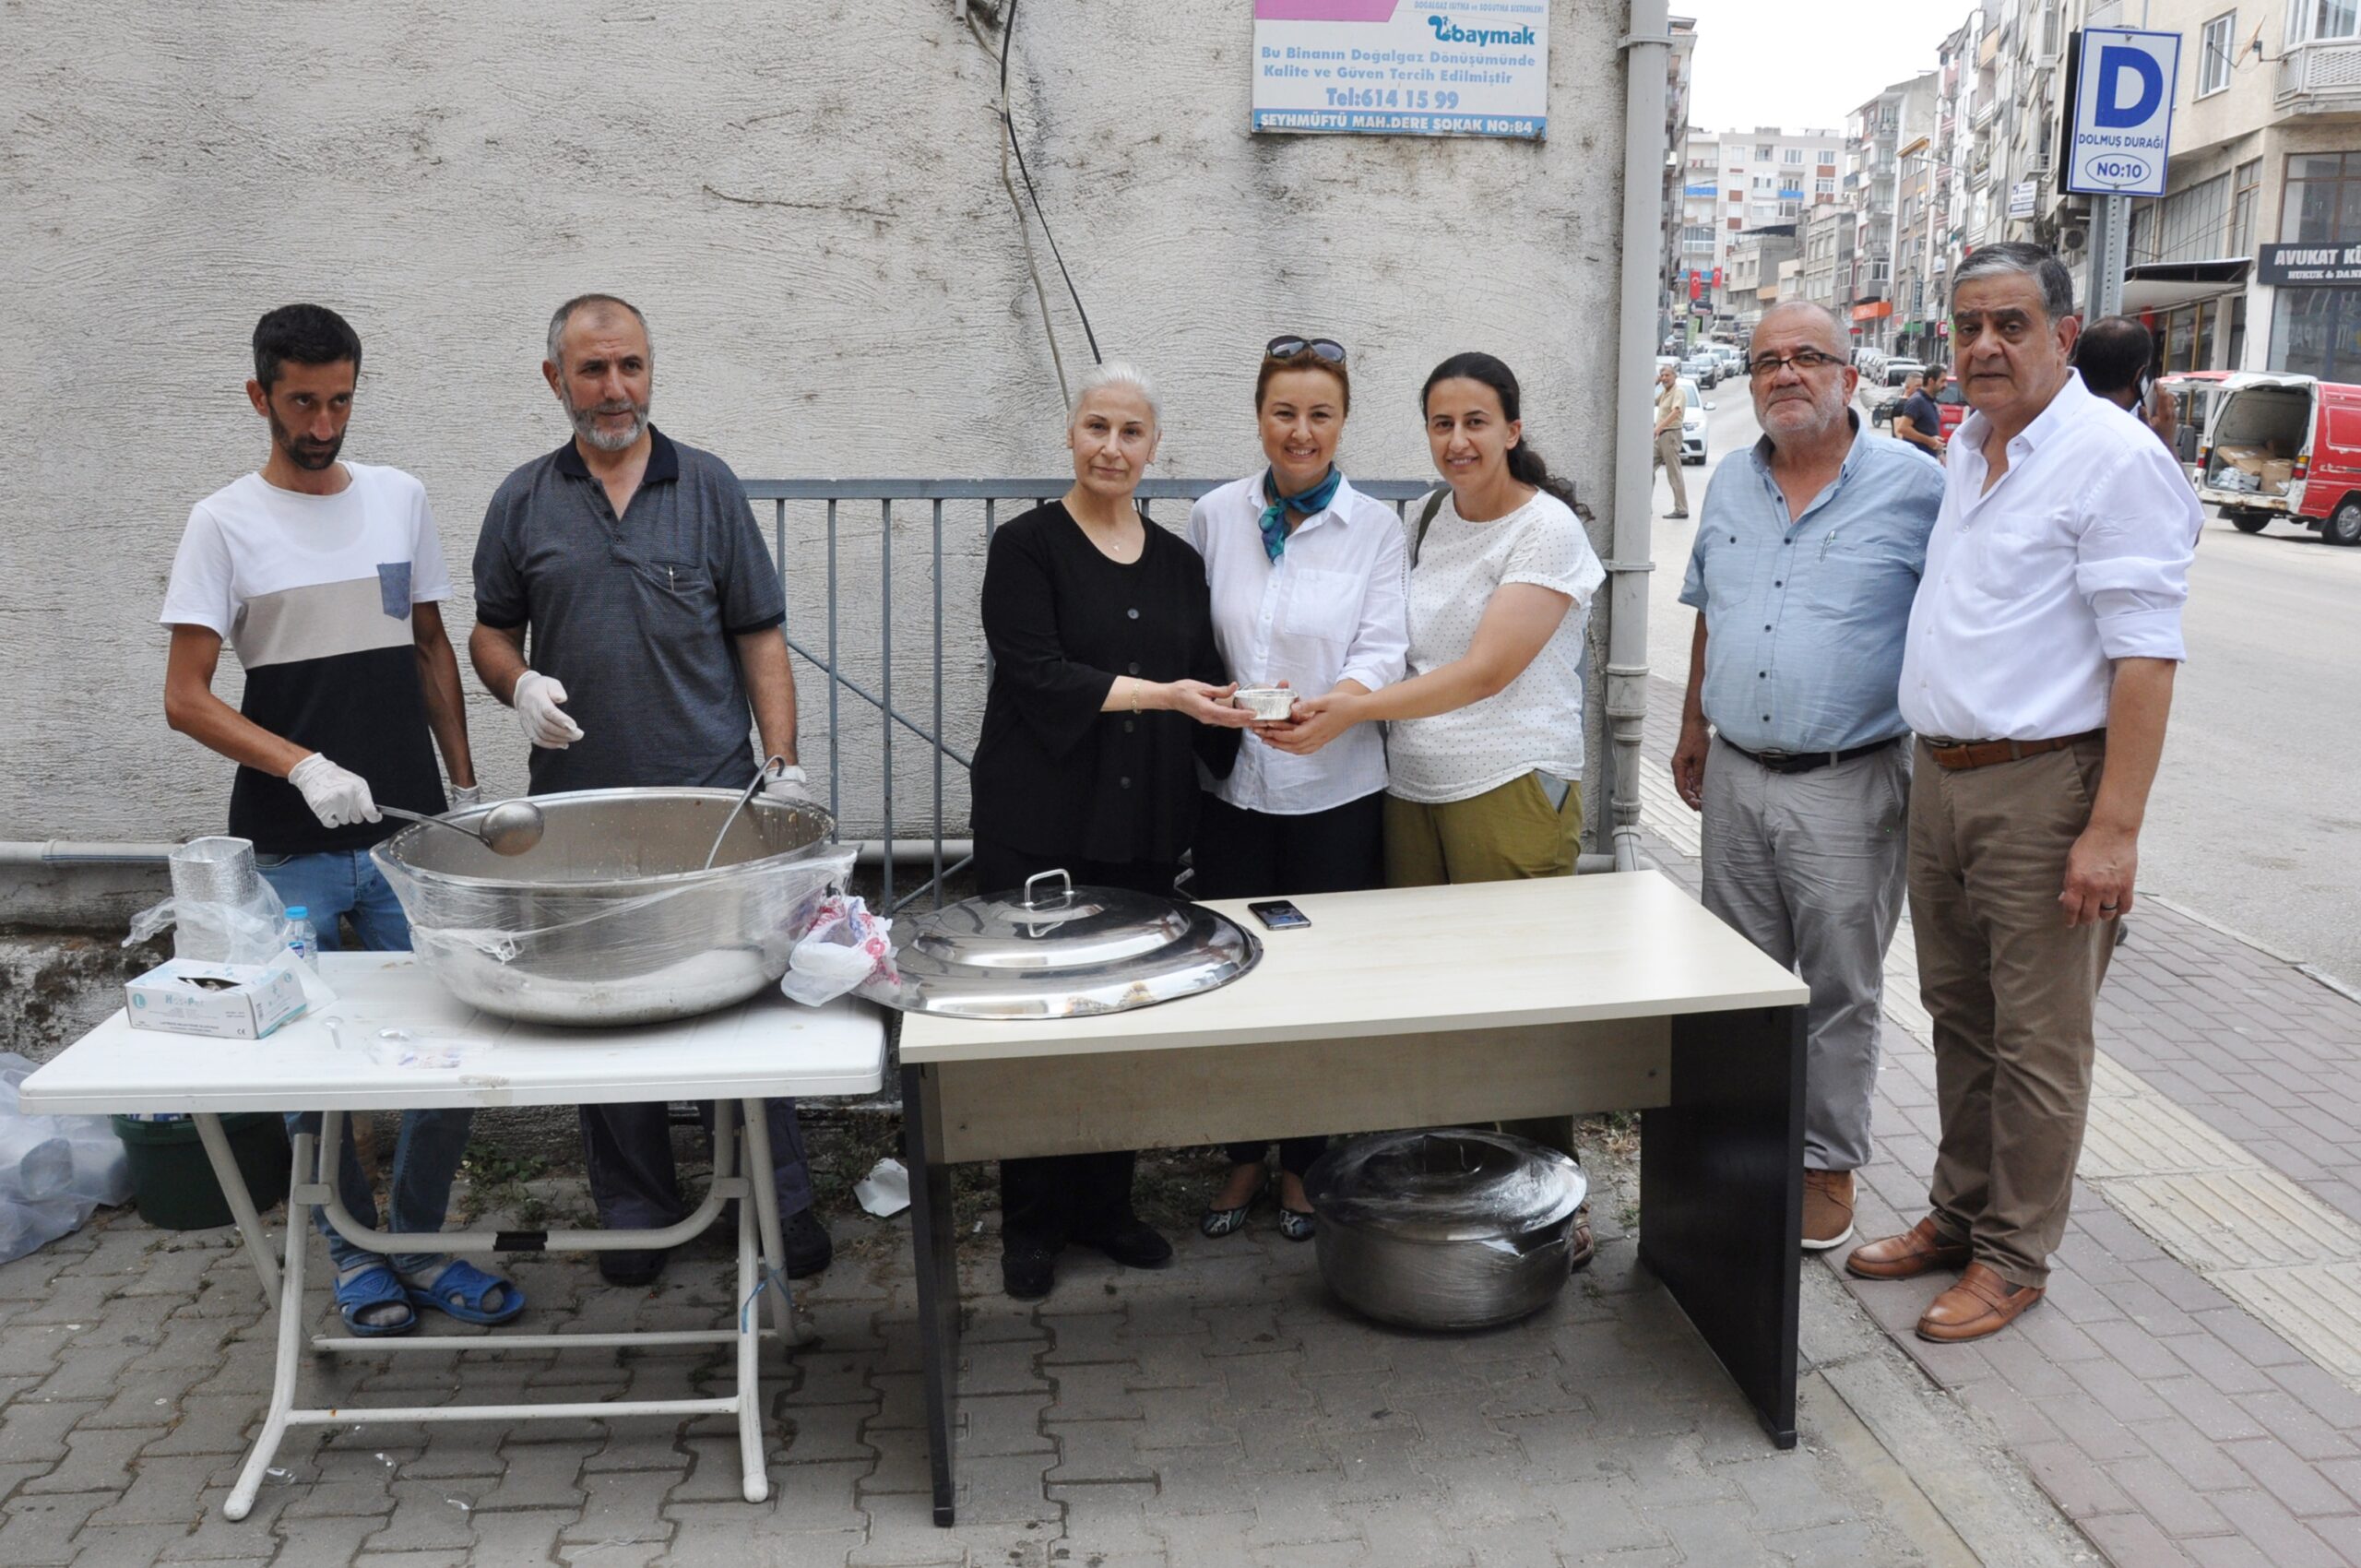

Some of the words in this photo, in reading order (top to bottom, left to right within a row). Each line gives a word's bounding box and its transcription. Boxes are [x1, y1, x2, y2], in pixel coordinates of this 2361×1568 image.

[1452, 24, 1536, 47] baymak
[1262, 47, 1280, 59] Bu
[1287, 47, 1346, 61] Binanın
[1351, 49, 1424, 65] Doğalgaz
[1430, 51, 1536, 67] Dönüşümünde
[1264, 65, 1309, 77] Kalite
[1314, 68, 1331, 77] ve
[1337, 66, 1383, 79] Güven
[1390, 67, 1434, 81] Tercih
[1441, 69, 1513, 86] Edilmiştir
[2094, 46, 2164, 128] D
[1325, 87, 1398, 108] Tel:614
[1406, 89, 1429, 109] 15
[1435, 90, 1459, 110] 99
[1432, 117, 1483, 131] SOKAK
[1487, 119, 1533, 133] NO:84
[2078, 134, 2121, 148] DOLMUŞ
[2124, 136, 2164, 148] DURAĞI
[2096, 162, 2142, 178] NO:10
[2273, 249, 2339, 266] AVUKAT
